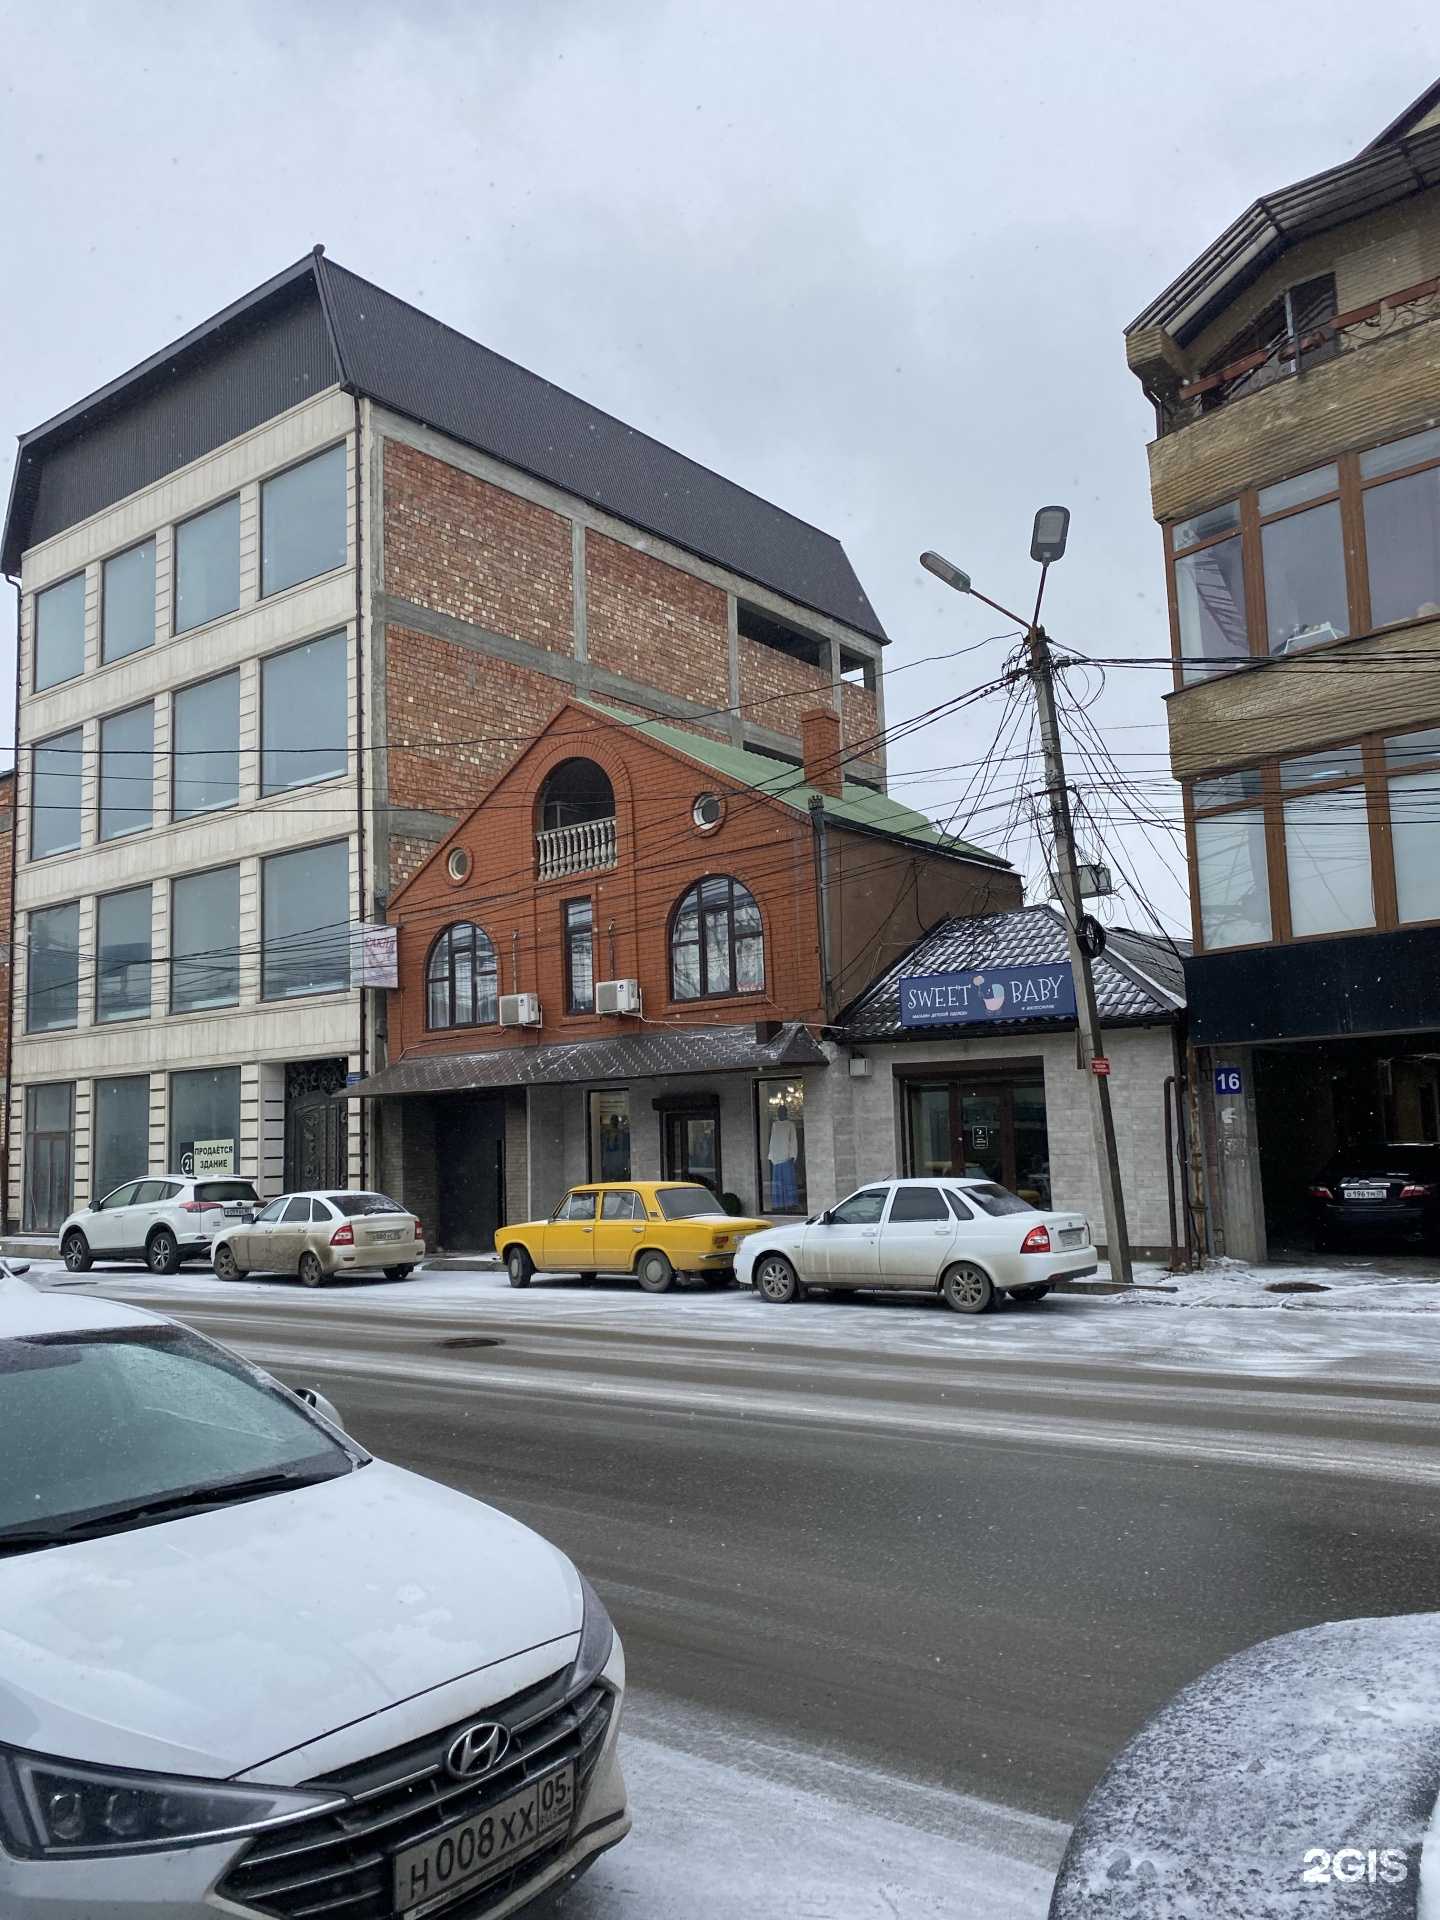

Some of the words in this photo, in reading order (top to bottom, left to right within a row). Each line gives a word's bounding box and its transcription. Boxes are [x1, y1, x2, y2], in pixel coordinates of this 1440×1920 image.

[908, 984, 972, 1009] SWEET
[1010, 975, 1065, 1004] BABY
[1217, 1073, 1240, 1090] 16
[200, 1159, 228, 1170] ЗДАНИЕ
